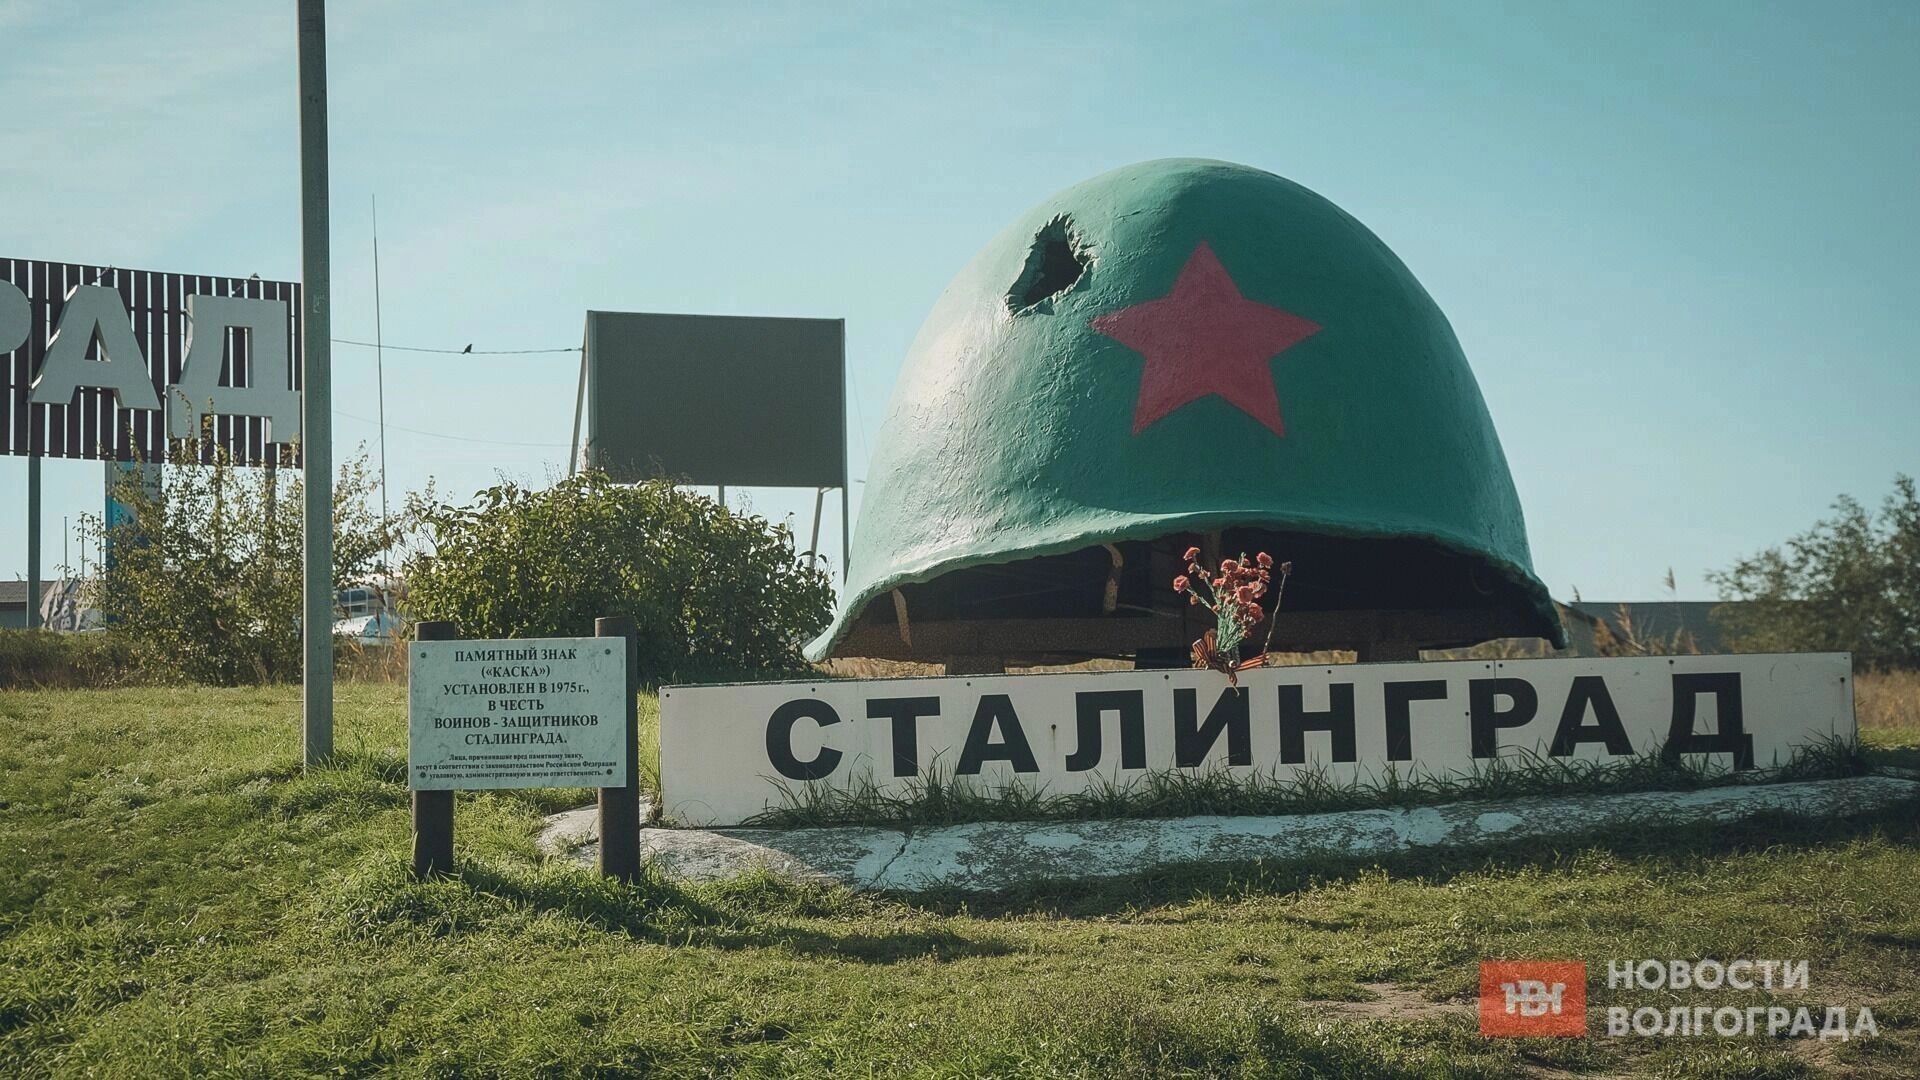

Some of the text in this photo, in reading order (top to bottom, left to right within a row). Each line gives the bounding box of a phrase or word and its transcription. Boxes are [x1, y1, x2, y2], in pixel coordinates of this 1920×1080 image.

[455, 647, 577, 662] ПАМЯТНЫЙ ЗНАК
[481, 664, 550, 679] («КАСКА»)
[443, 682, 535, 696] УСТАНОВЛЕН
[539, 682, 548, 694] В
[488, 699, 544, 711] В ЧЕСТЬ
[434, 716, 491, 729] ВОИНОВ
[501, 714, 599, 729] ЗАЩИТНИКОВ
[764, 672, 1753, 780] СТАЛИНГРАД
[465, 732, 568, 746] СТАЛИНГРАДА.
